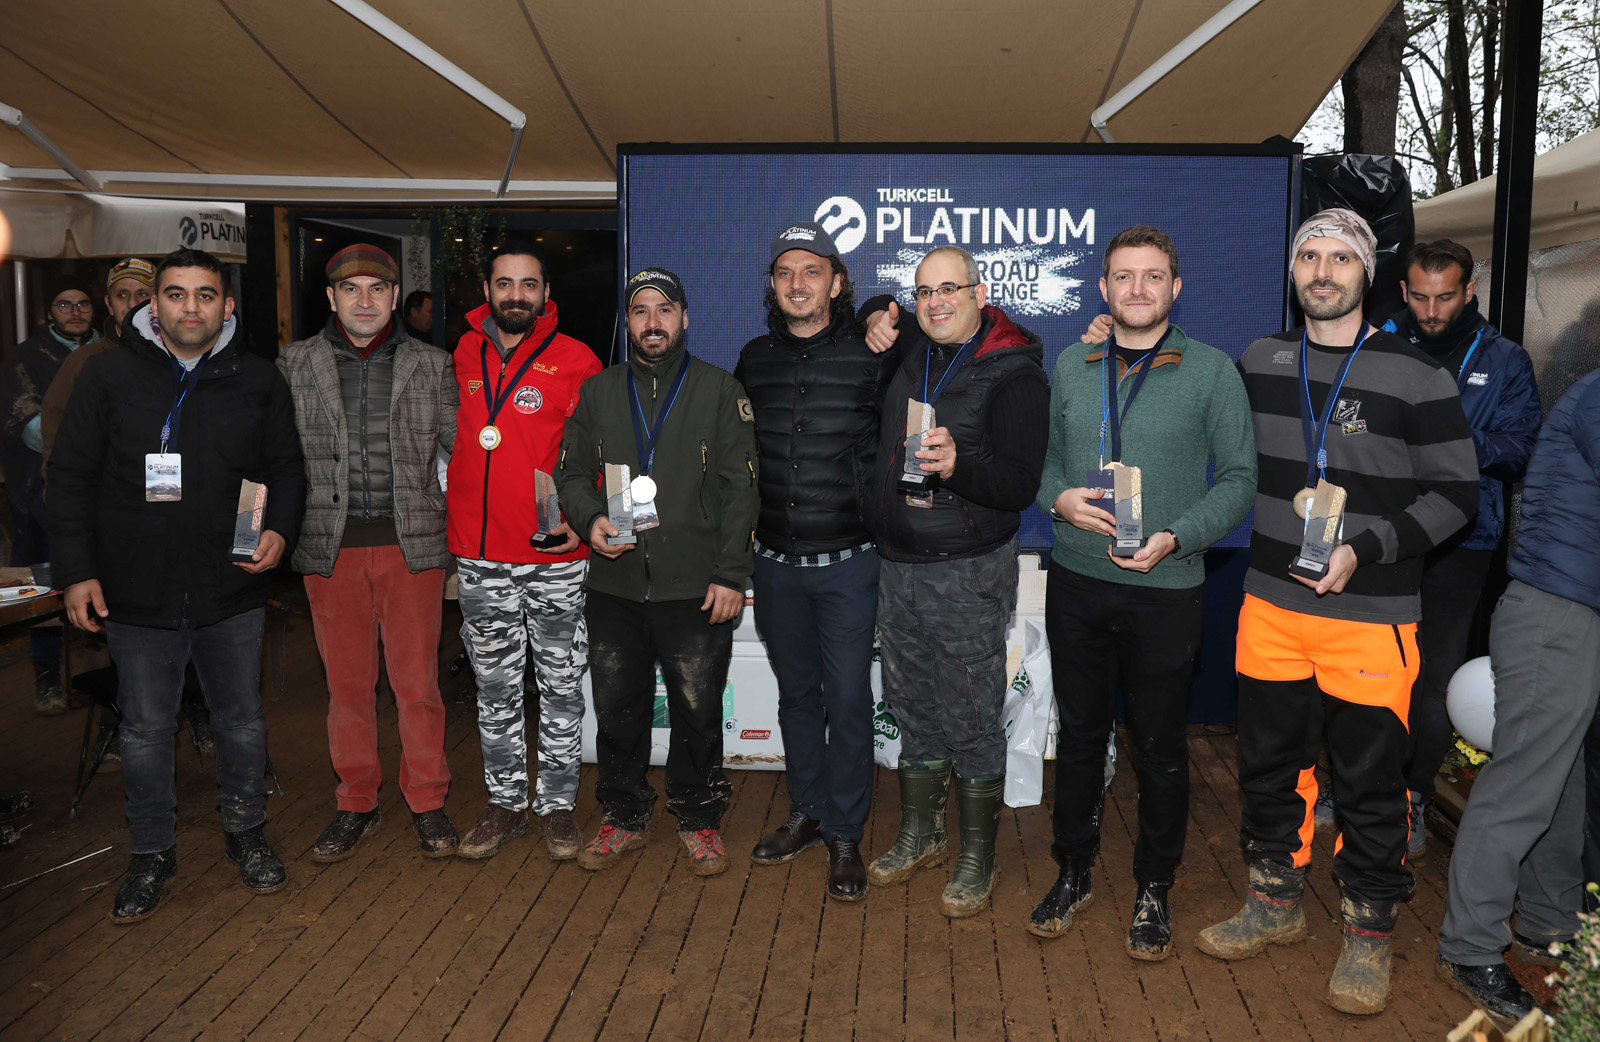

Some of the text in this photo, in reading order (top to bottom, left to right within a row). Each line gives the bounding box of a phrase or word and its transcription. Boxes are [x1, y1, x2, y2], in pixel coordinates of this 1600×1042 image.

[877, 188, 954, 202] TURKCELL
[876, 207, 1096, 245] PLATINUM
[986, 283, 1039, 300] ENGE
[742, 730, 765, 738] Coleman
